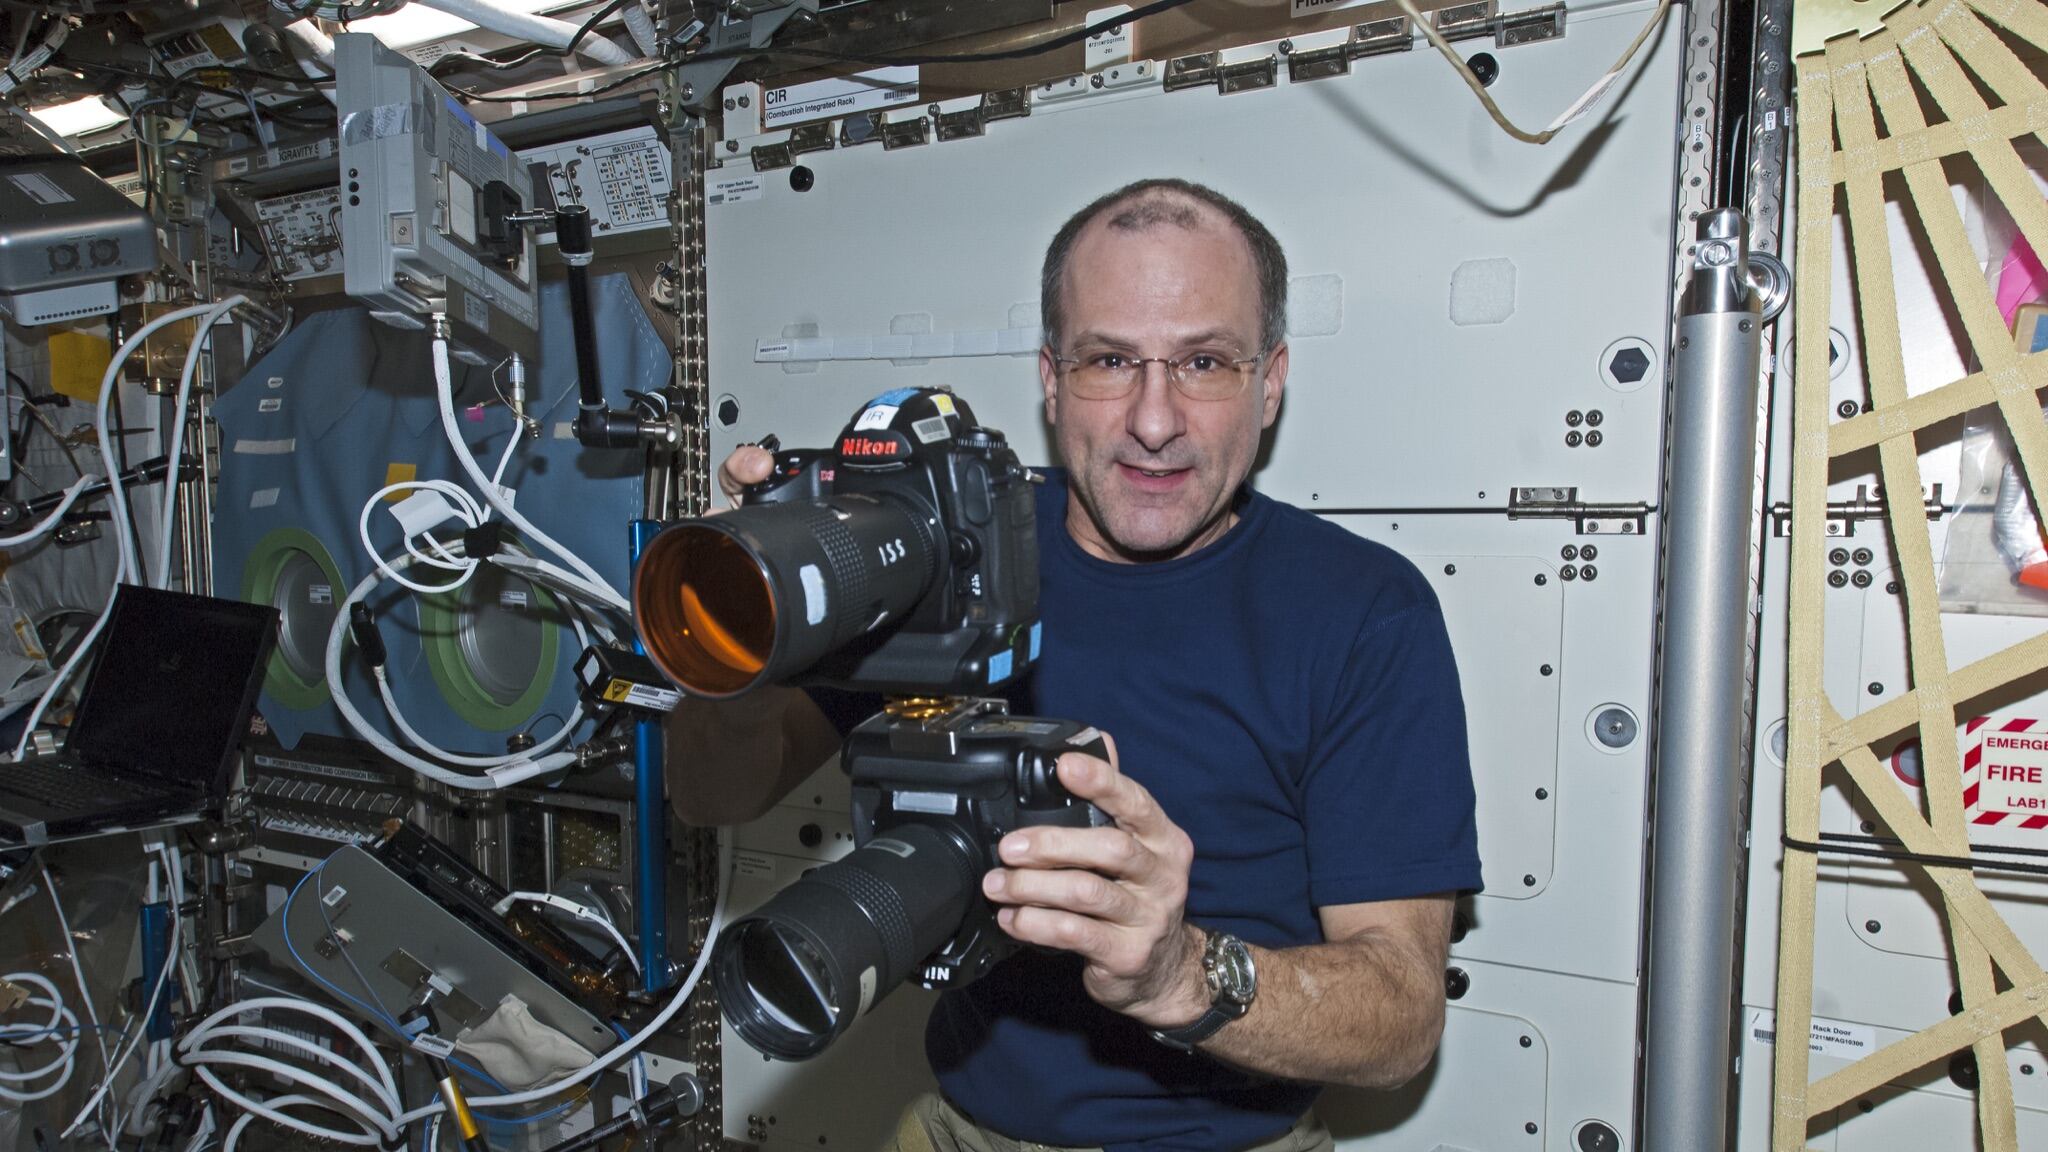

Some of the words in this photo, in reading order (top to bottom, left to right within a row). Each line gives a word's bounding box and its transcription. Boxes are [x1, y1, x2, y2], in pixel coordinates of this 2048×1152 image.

[766, 89, 787, 104] CIR
[766, 107, 804, 121] (Combustion
[805, 101, 836, 114] Integrated
[838, 97, 855, 107] Rack)
[866, 411, 884, 422] IR
[842, 438, 898, 456] Nikon
[878, 538, 906, 567] ISS
[1987, 764, 2042, 784] FIRE
[1813, 1024, 1831, 1034] Rack
[1833, 1027, 1851, 1036] Door
